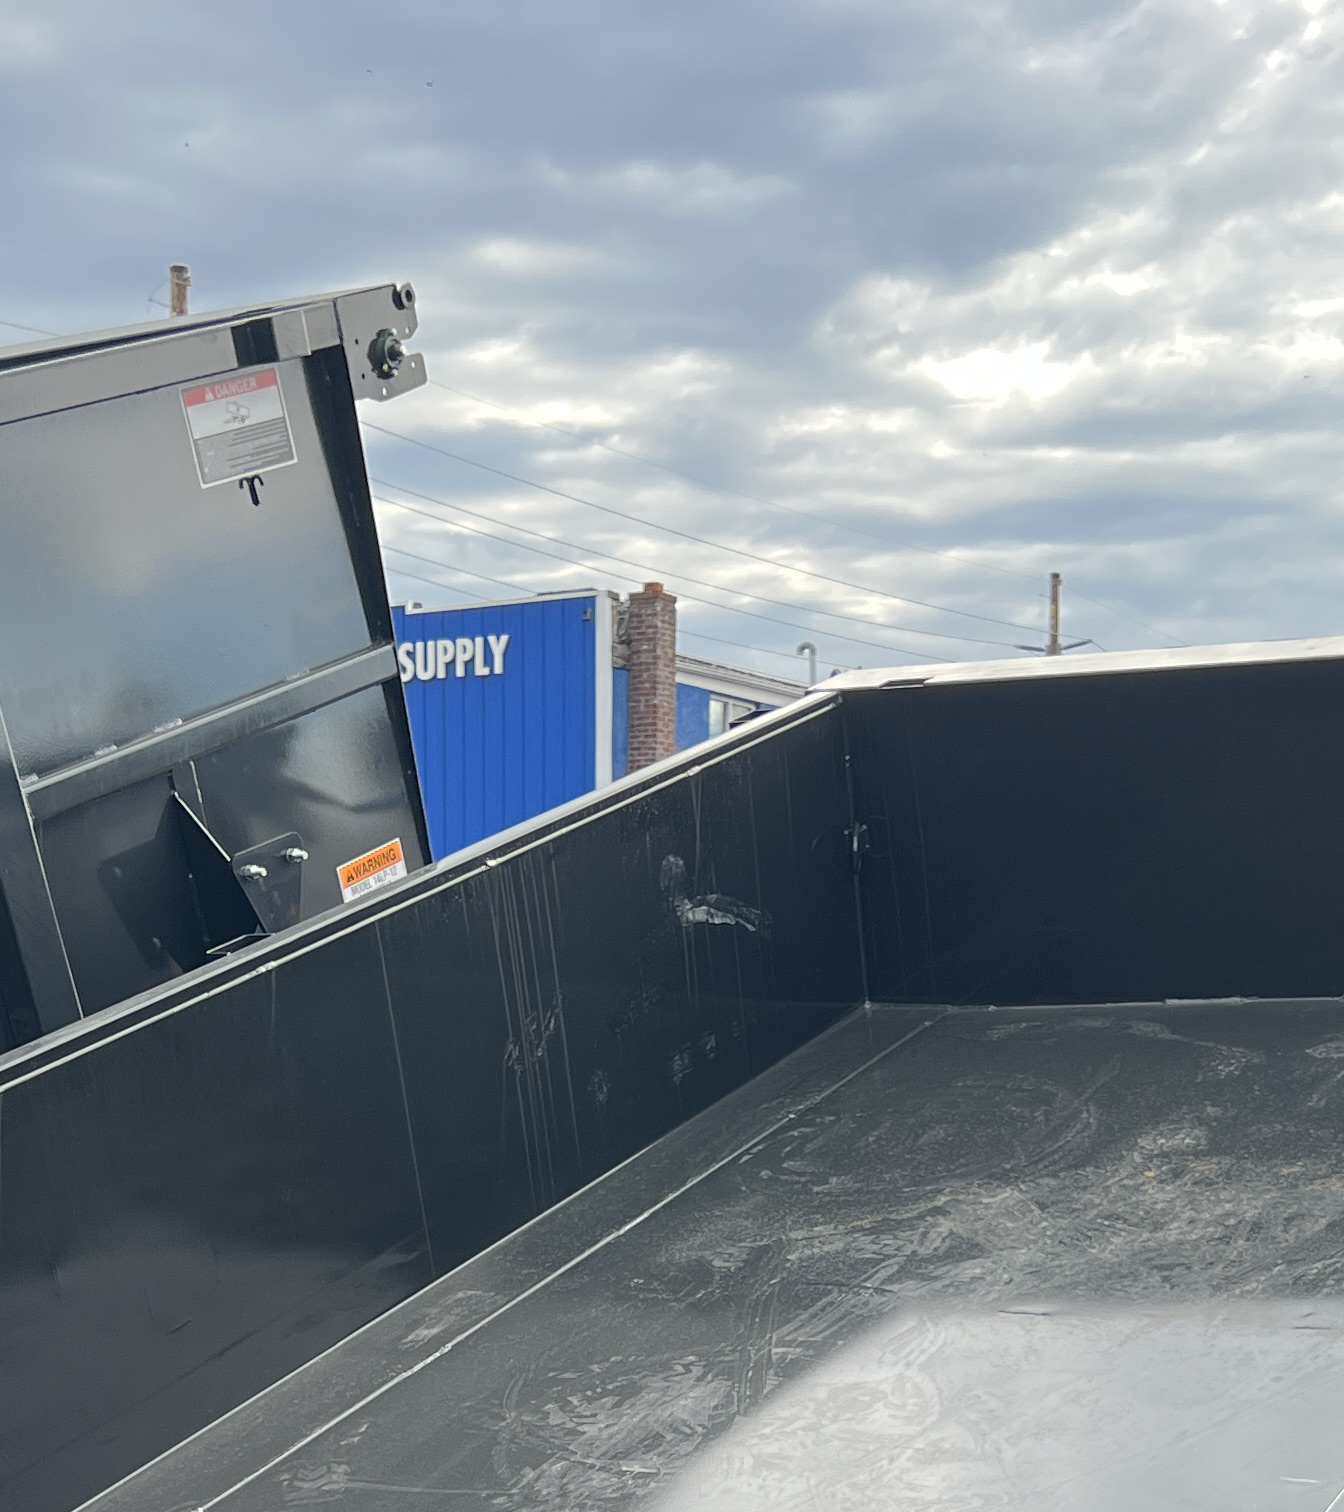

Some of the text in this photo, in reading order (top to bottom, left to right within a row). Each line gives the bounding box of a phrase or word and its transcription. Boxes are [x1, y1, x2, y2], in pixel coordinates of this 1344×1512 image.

[216, 376, 257, 399] DANGER
[398, 634, 510, 683] SUPPLY
[353, 848, 397, 879] WARNING
